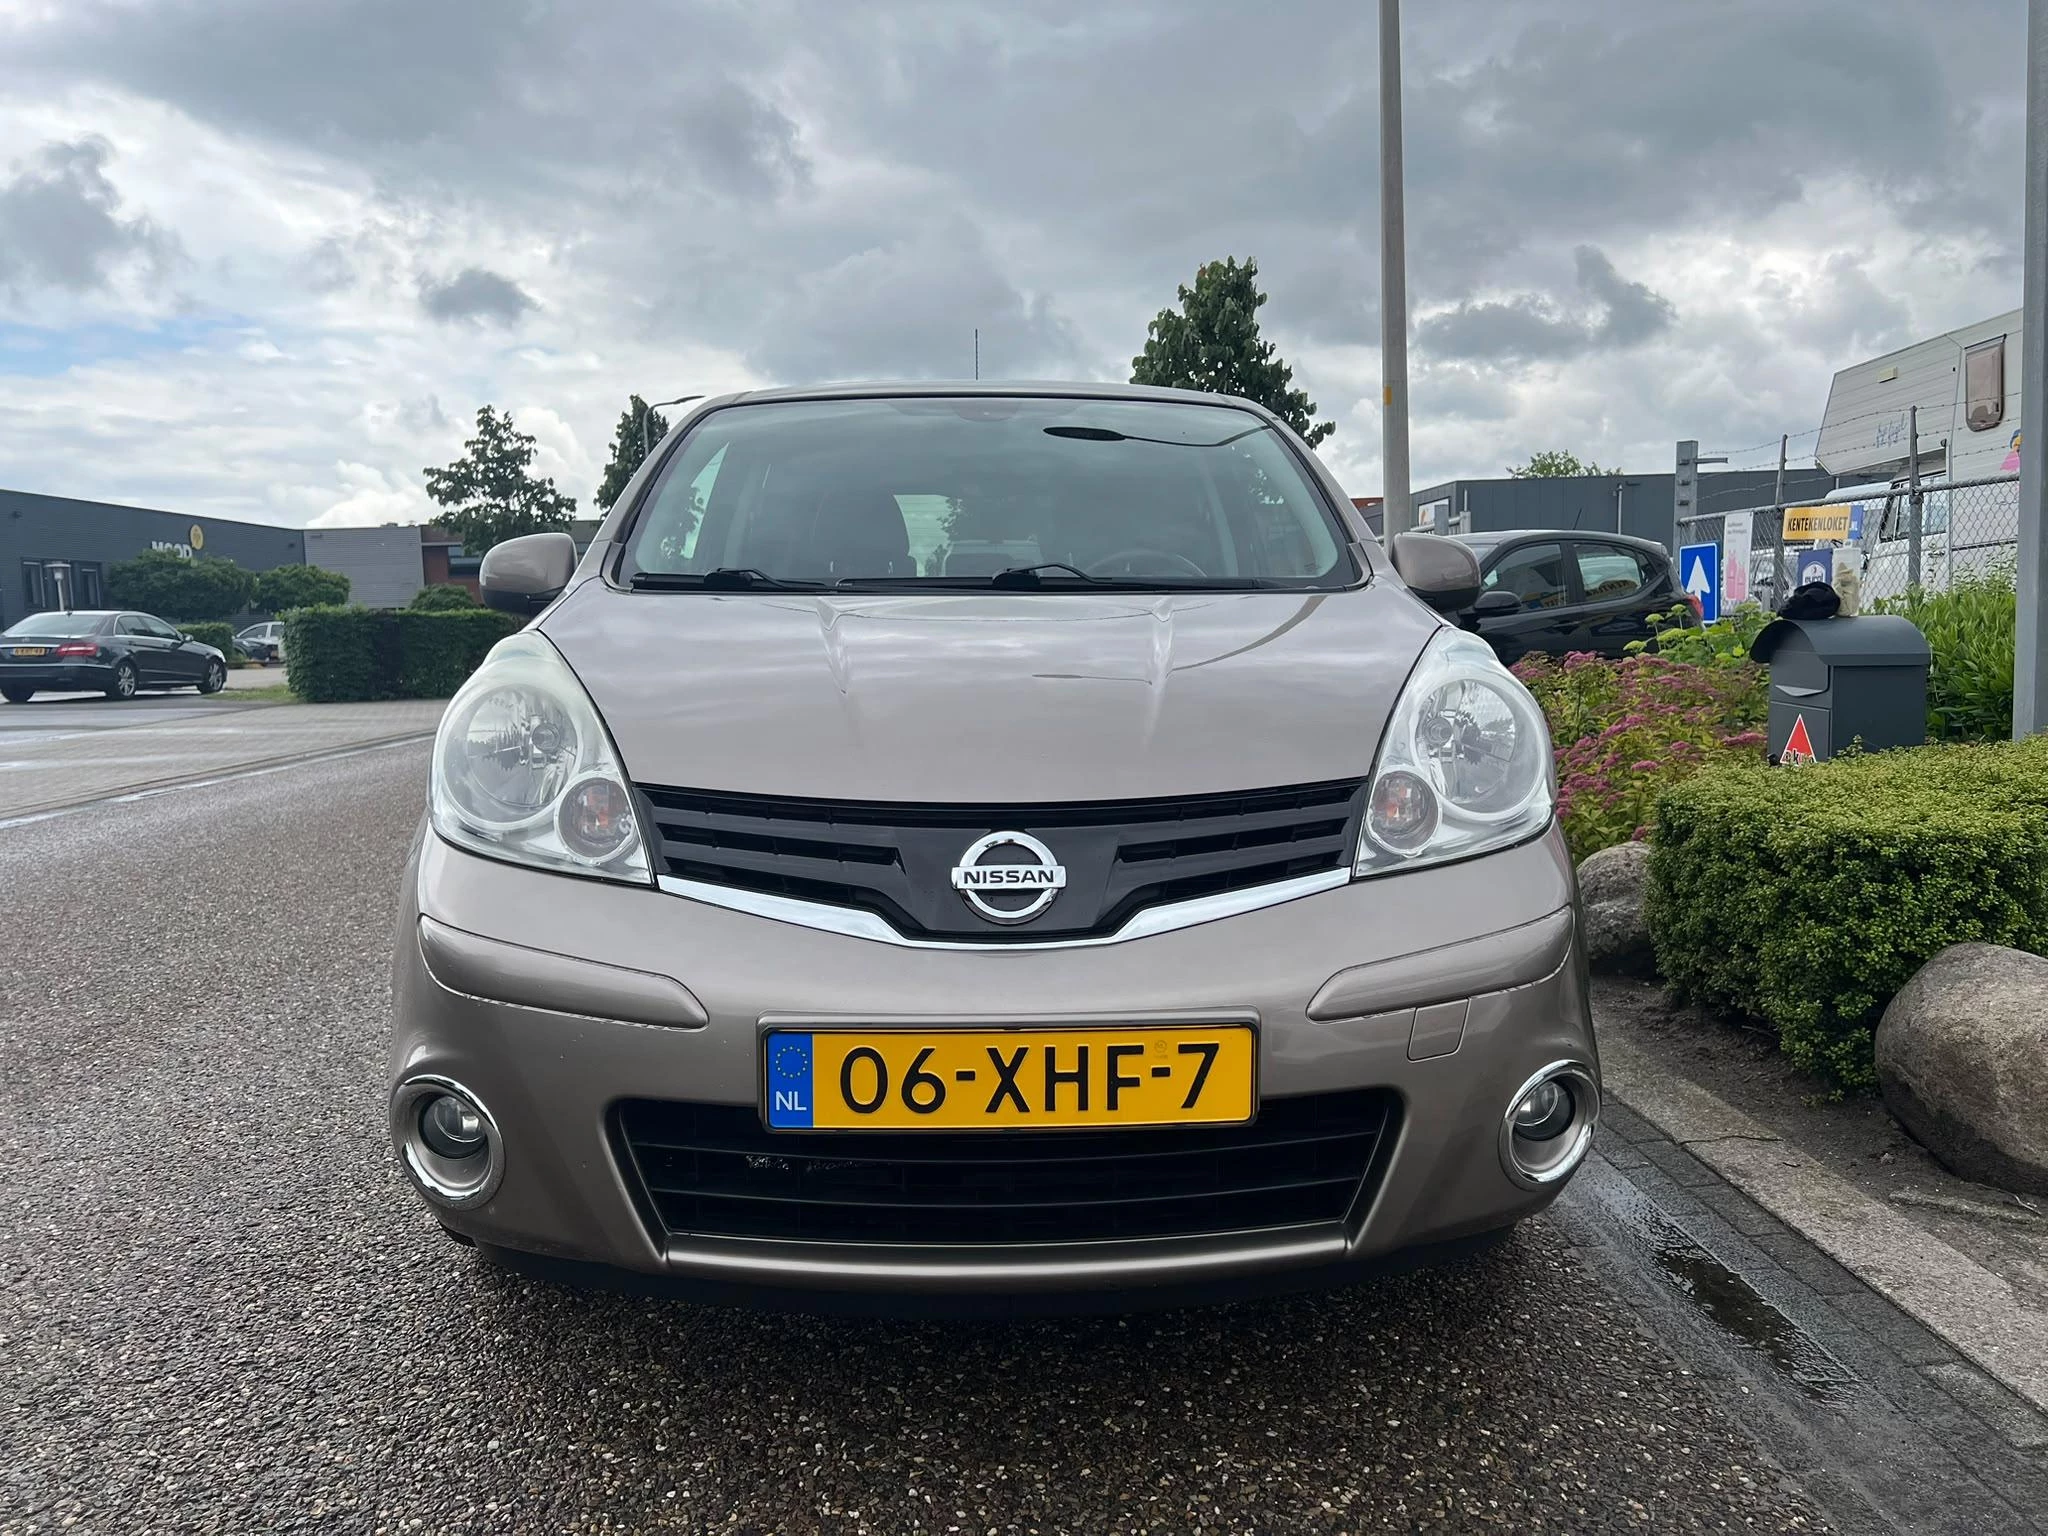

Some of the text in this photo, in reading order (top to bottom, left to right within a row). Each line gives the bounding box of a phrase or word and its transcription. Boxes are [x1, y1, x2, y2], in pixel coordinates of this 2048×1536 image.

[1787, 516, 1848, 532] KENTEKENLOKET
[964, 870, 1054, 884] NISSAN
[840, 1042, 1220, 1114] 06-XHF-7
[775, 1091, 807, 1111] NL
